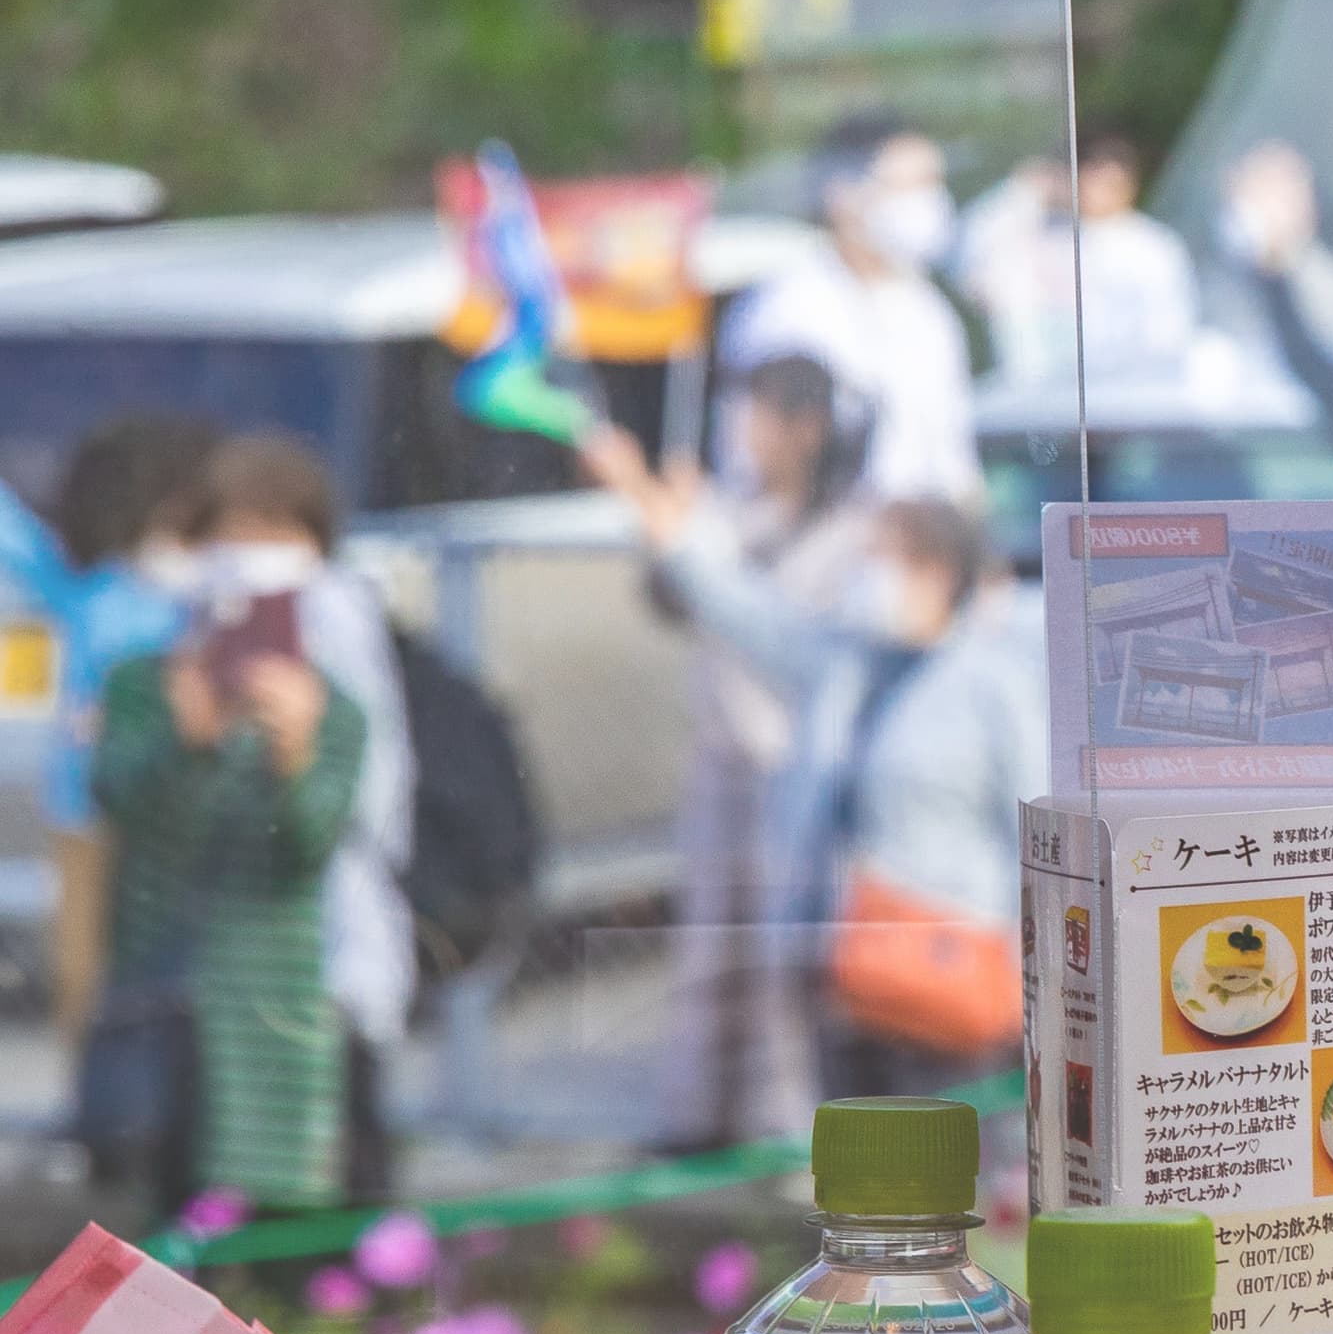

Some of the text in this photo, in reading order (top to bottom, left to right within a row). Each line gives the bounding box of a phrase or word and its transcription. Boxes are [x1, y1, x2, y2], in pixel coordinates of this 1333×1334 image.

[1174, 835, 1261, 870] ケーキ
[1137, 1060, 1310, 1095] キャラメルバナナタルト
[1145, 1094, 1300, 1122] サクサクのタルト生地とキャ
[1145, 1114, 1297, 1143] ラメルバナナの上品な甘さ
[1145, 1157, 1293, 1185] 珈琲やお紅茶のお供にい
[1240, 1243, 1314, 1268] (HOT/ICE)
[1237, 1271, 1312, 1296] (HOT/ICE)
